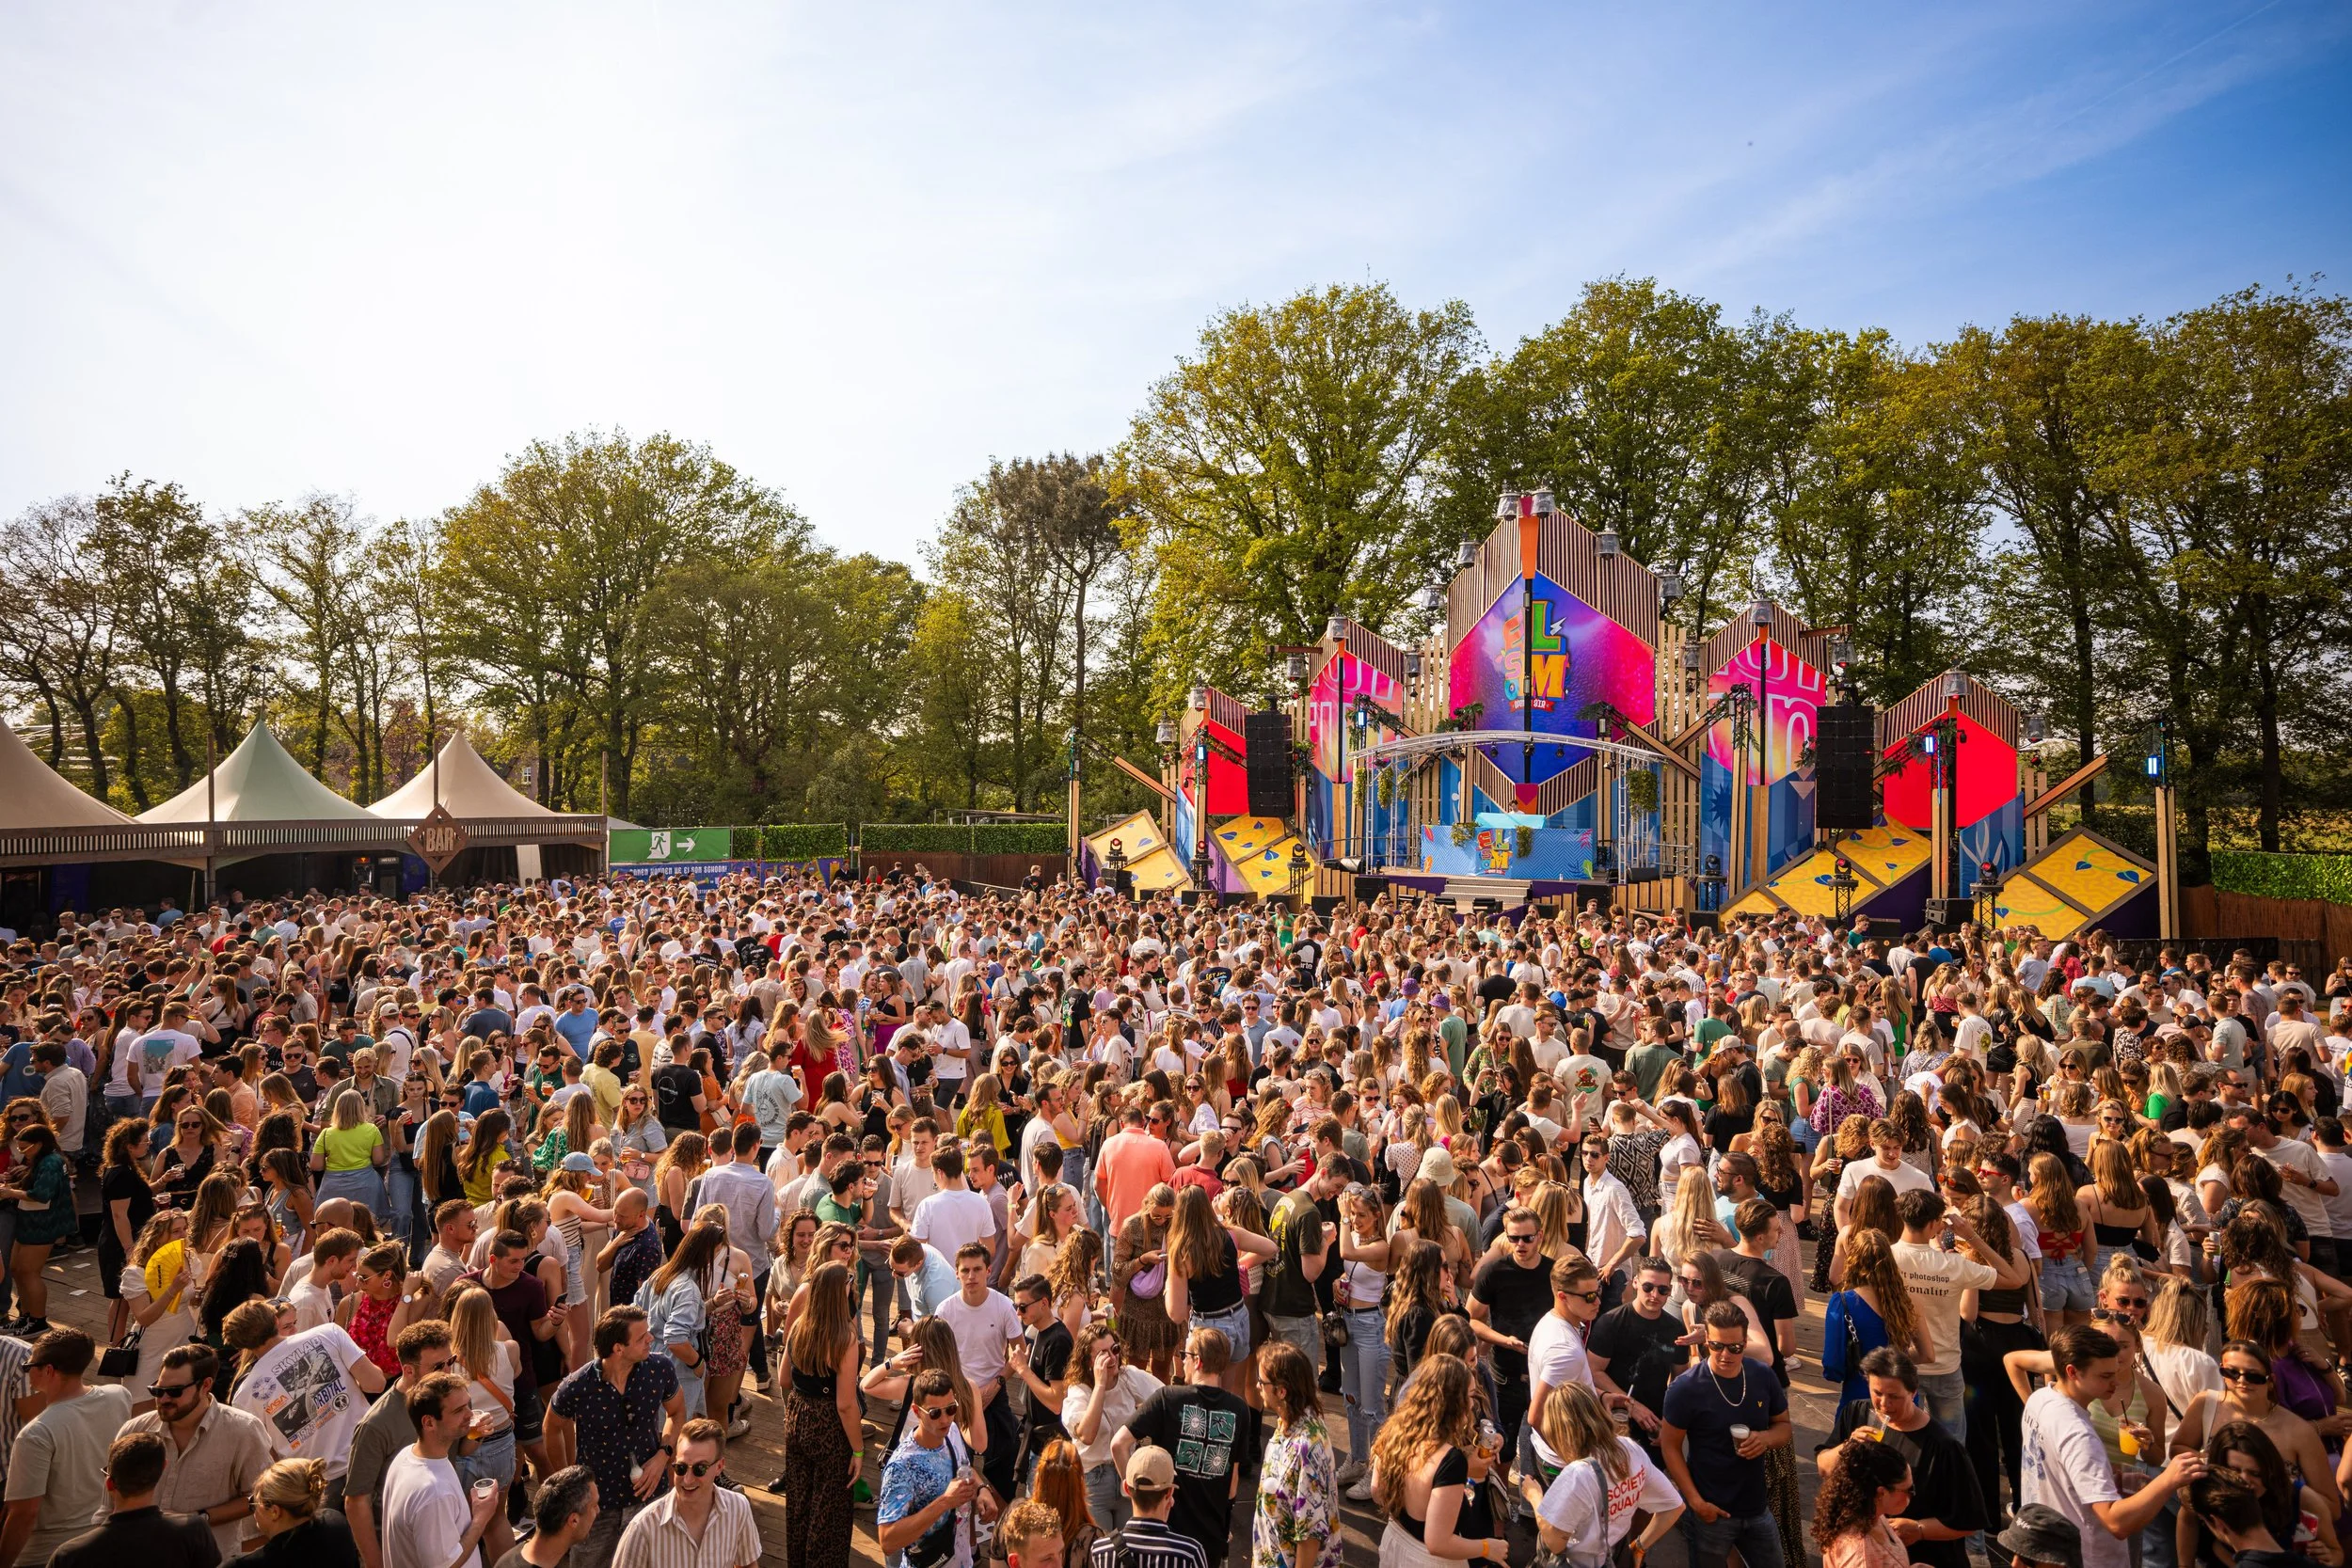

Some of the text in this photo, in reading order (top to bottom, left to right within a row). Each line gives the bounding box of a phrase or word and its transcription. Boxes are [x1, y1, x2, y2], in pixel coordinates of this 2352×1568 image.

[425, 827, 453, 852] BAR
[1909, 1272, 1950, 1283] photoshop
[272, 1336, 322, 1377] SKYLAB
[265, 1395, 289, 1415] NASA
[313, 1379, 346, 1410] ORBITAL
